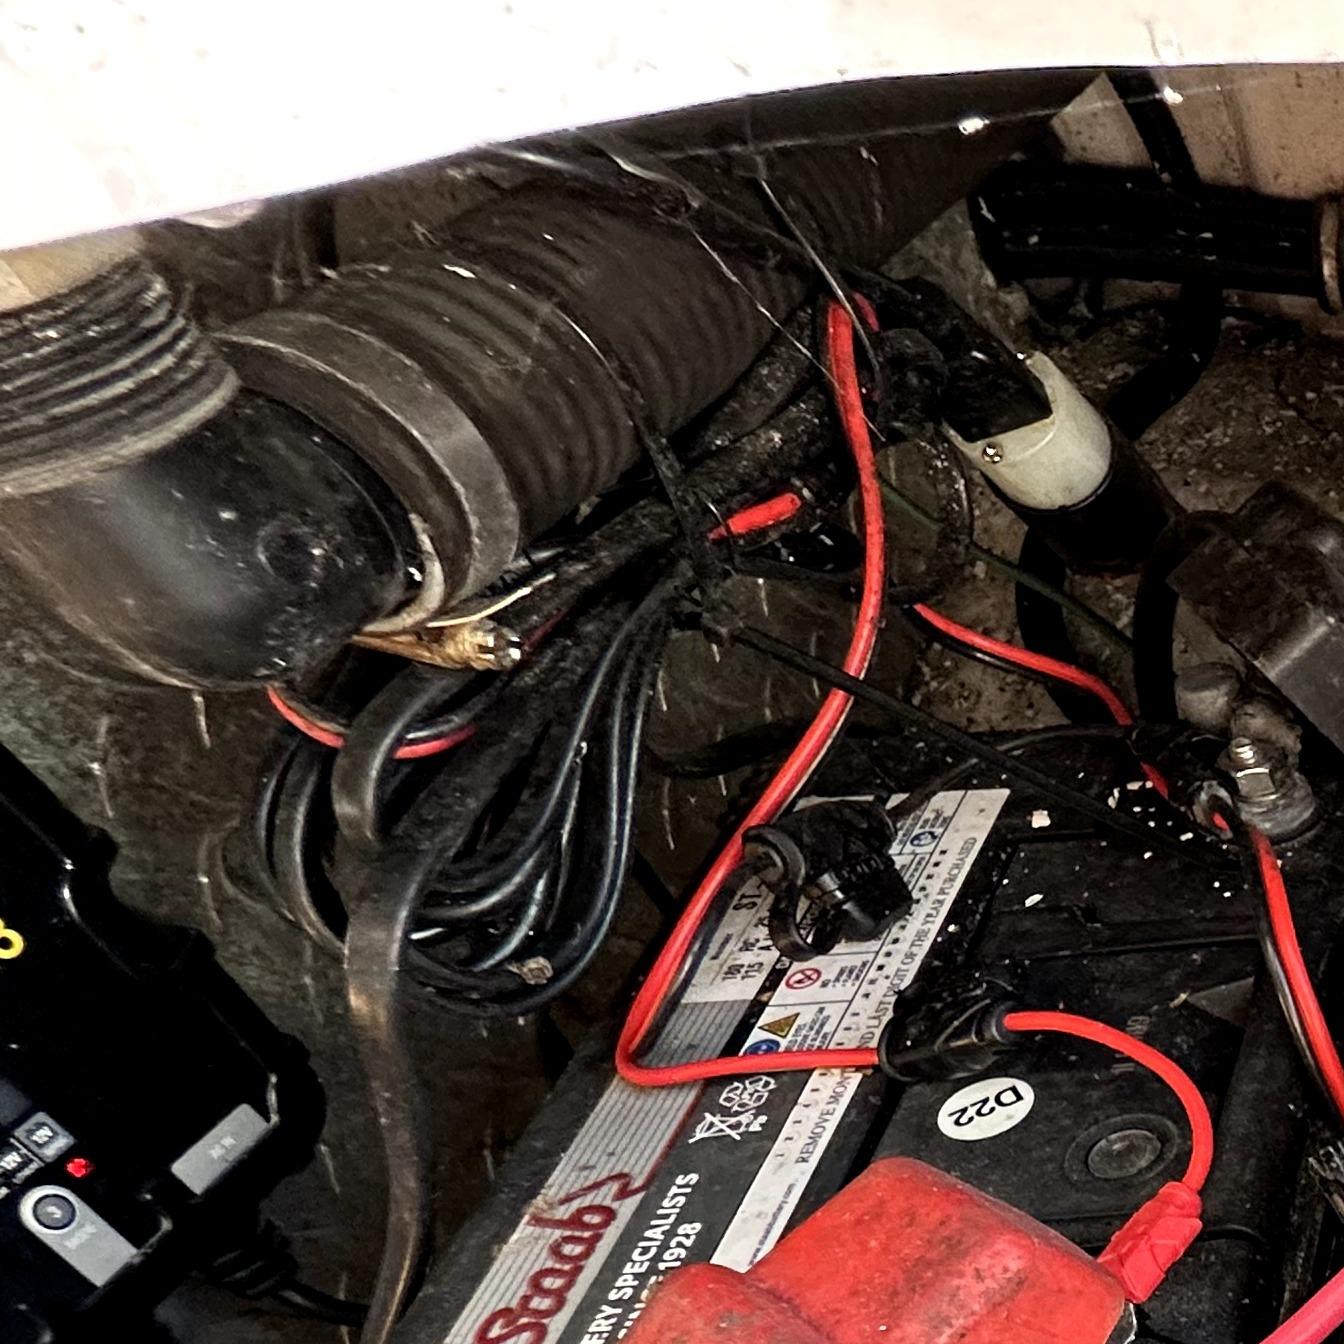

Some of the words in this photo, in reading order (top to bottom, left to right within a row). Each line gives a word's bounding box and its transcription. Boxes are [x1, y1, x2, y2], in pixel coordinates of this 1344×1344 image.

[936, 835, 978, 898] PURCHASED
[920, 896, 946, 926] YEAR
[898, 946, 919, 966] OF
[908, 925, 931, 949] THE
[865, 999, 892, 1029] LAST
[947, 1082, 1025, 1127] D22
[793, 1108, 836, 1164] REMOVE
[607, 1172, 699, 1302] SPECIALISTS
[658, 1221, 703, 1271] 1928
